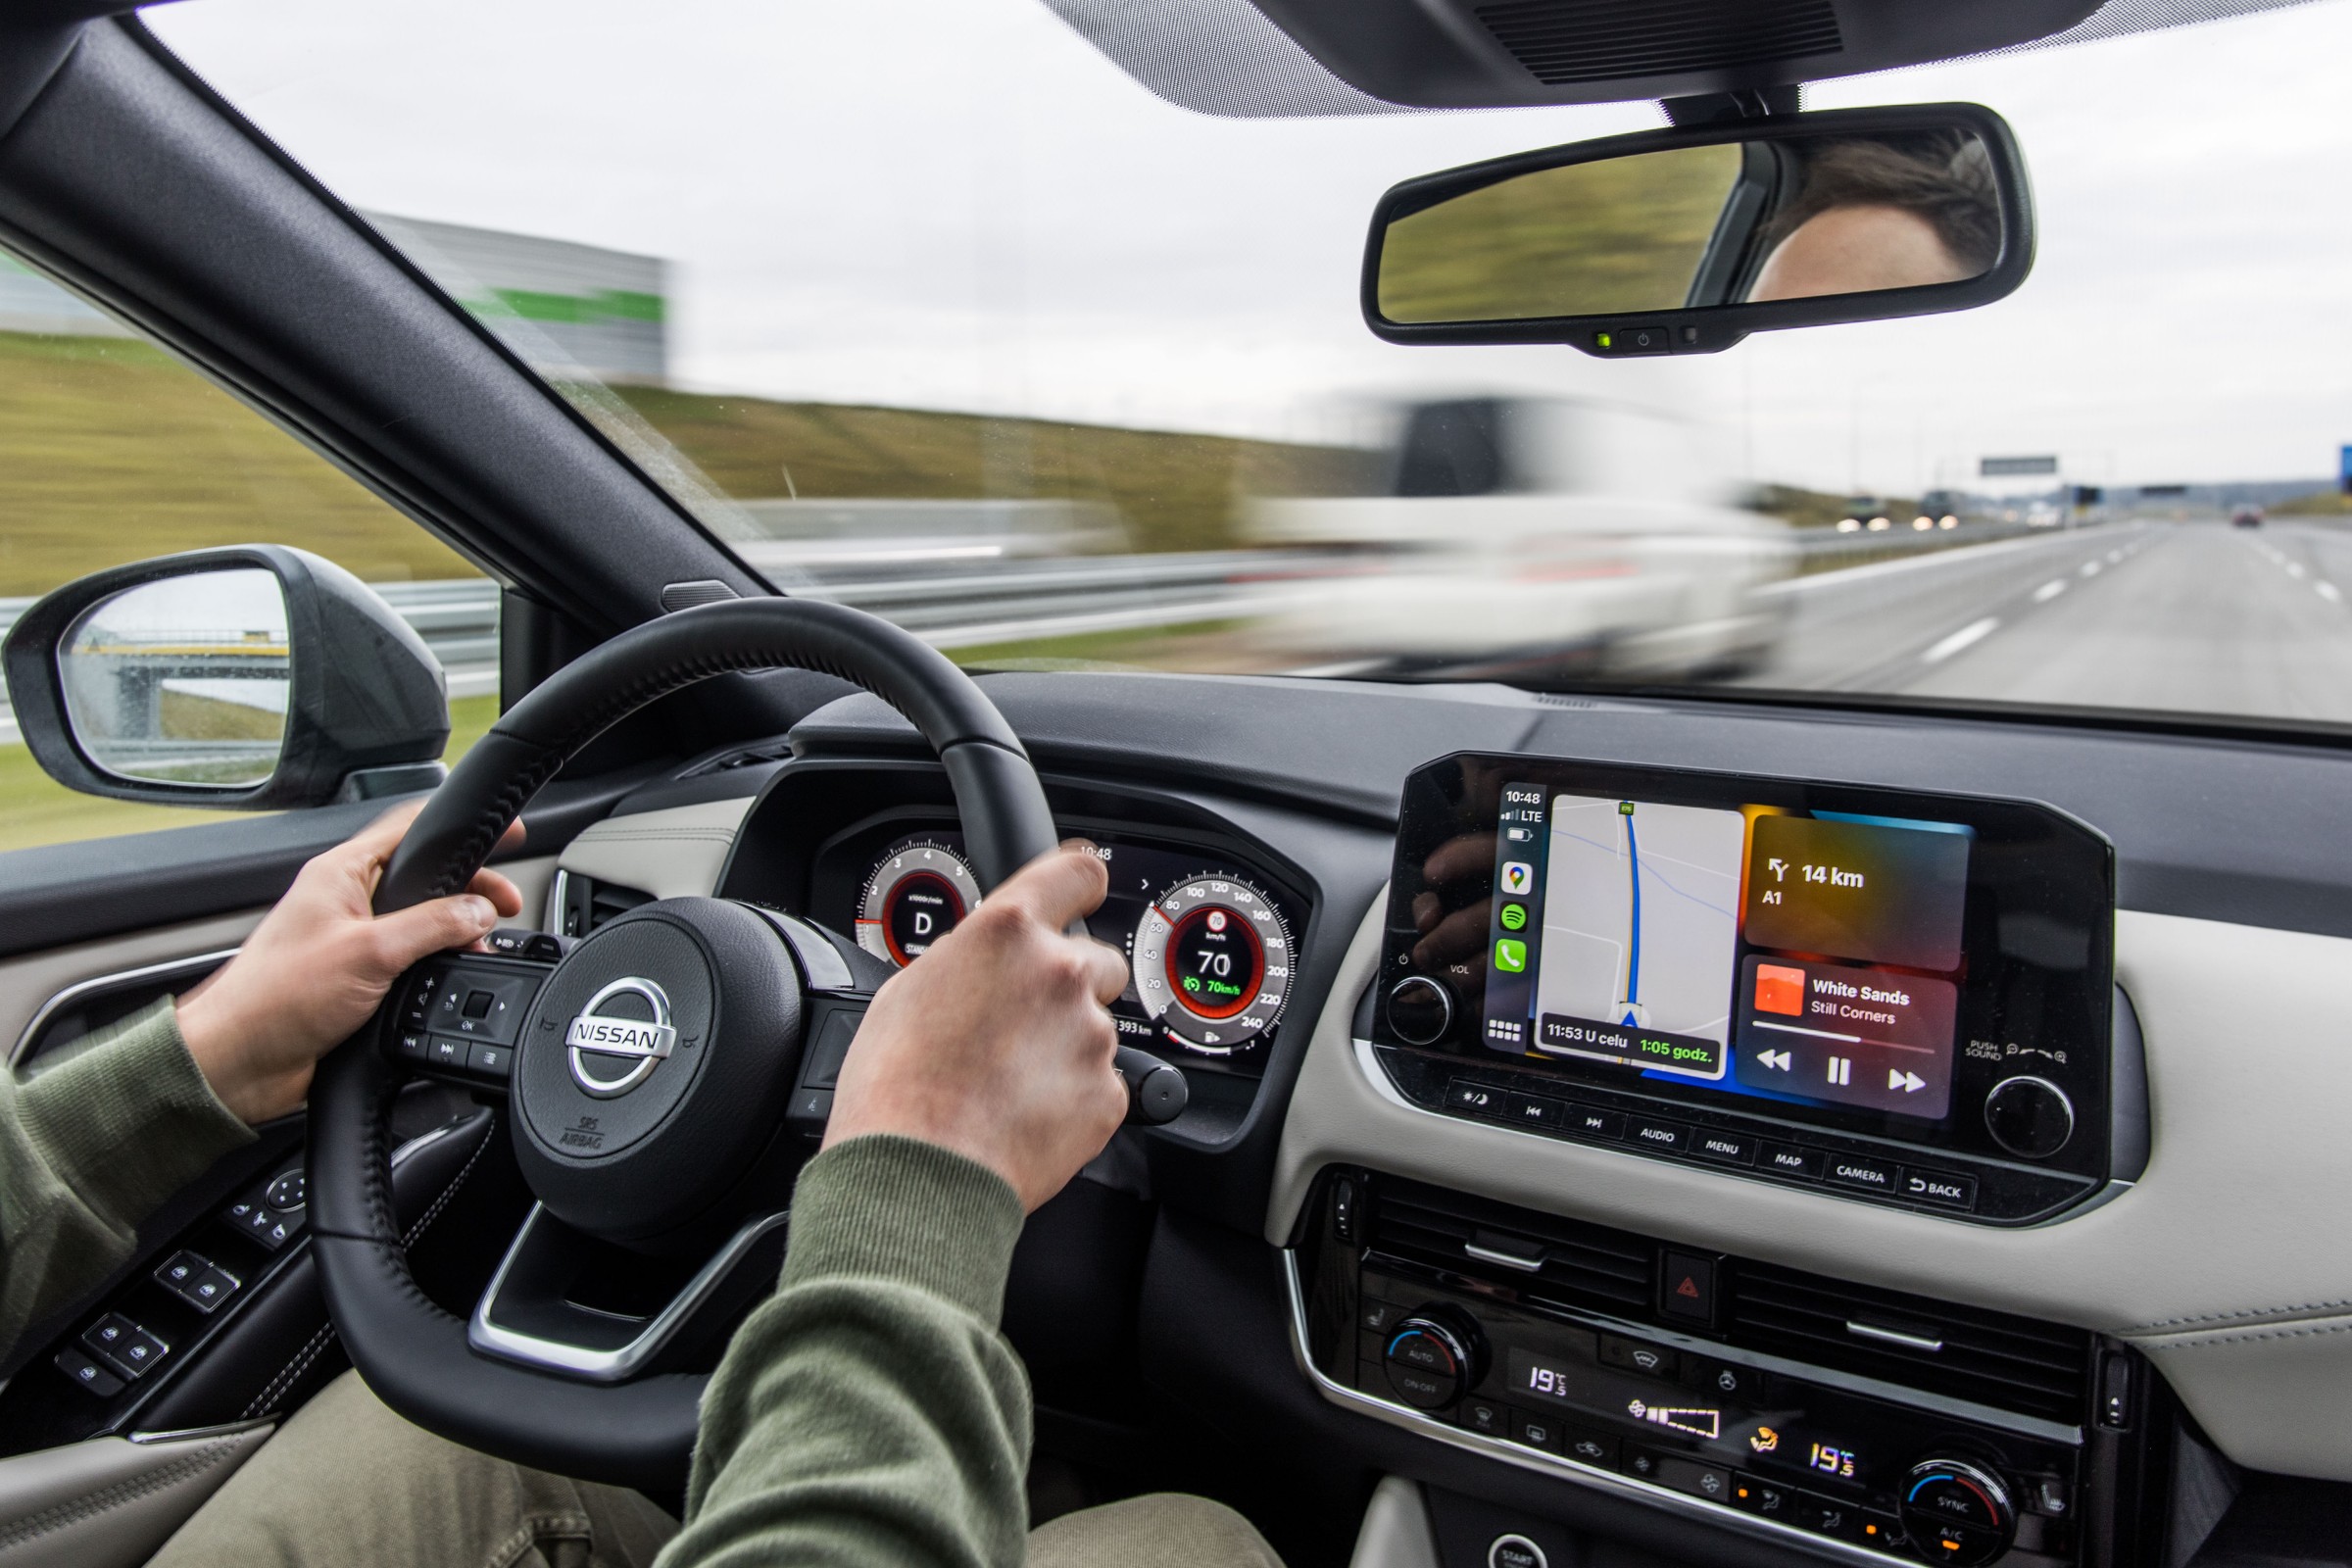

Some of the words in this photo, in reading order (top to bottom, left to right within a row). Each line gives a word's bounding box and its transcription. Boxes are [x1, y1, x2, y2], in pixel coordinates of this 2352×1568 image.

[1506, 790, 1542, 805] 10:48
[1521, 809, 1544, 823] LTE
[923, 850, 932, 860] 4
[1081, 846, 1112, 860] 10:48
[894, 858, 902, 869] 3
[956, 865, 964, 877] 5
[1802, 864, 1828, 884] 14
[1830, 866, 1865, 889] km
[870, 885, 879, 896] 2
[1186, 886, 1205, 899] 100
[1210, 882, 1229, 894] 120
[974, 899, 982, 908] 6
[1234, 891, 1253, 904] 140
[1762, 890, 1783, 906] A1
[1165, 901, 1181, 910] 80
[1211, 914, 1223, 927] 70
[1252, 909, 1272, 922] 160
[914, 911, 933, 935] D
[1150, 922, 1164, 933] 60
[1205, 931, 1227, 942] km/h
[1265, 937, 1286, 950] 180
[1144, 950, 1158, 960] 40
[1198, 951, 1232, 977] 70
[1450, 964, 1470, 975] VOL
[1267, 965, 1289, 978] 200
[1148, 979, 1161, 990] 20
[1259, 993, 1282, 1005] 220
[1813, 978, 1858, 999] White
[1860, 985, 1911, 1006] Sands
[1158, 1004, 1168, 1014] 0
[1811, 1000, 1838, 1016] Still
[1839, 1004, 1896, 1025] Corners
[1118, 1020, 1139, 1034] 393
[1138, 1025, 1152, 1037] km
[1241, 1016, 1264, 1029] 240
[574, 1023, 659, 1050] NISSAN
[1547, 1023, 1584, 1041] 11:53
[1585, 1029, 1597, 1043] U
[1598, 1034, 1629, 1049] celu
[1640, 1039, 1671, 1055] 1:05
[1672, 1046, 1714, 1063] godz.
[1970, 1040, 1999, 1053] PUSH
[1965, 1047, 2003, 1061] SOUND
[577, 1116, 599, 1131] SRS
[559, 1132, 604, 1150] AIRBAG
[1640, 1128, 1675, 1143] AUDIO
[1705, 1140, 1740, 1155] MENU
[1775, 1153, 1803, 1167] MAP
[1836, 1165, 1886, 1184] CAMERA
[1928, 1183, 1962, 1199] BACK
[1408, 1349, 1435, 1363] AUTO
[1937, 1496, 1969, 1513] SYNC
[1940, 1527, 1964, 1542] A/C
